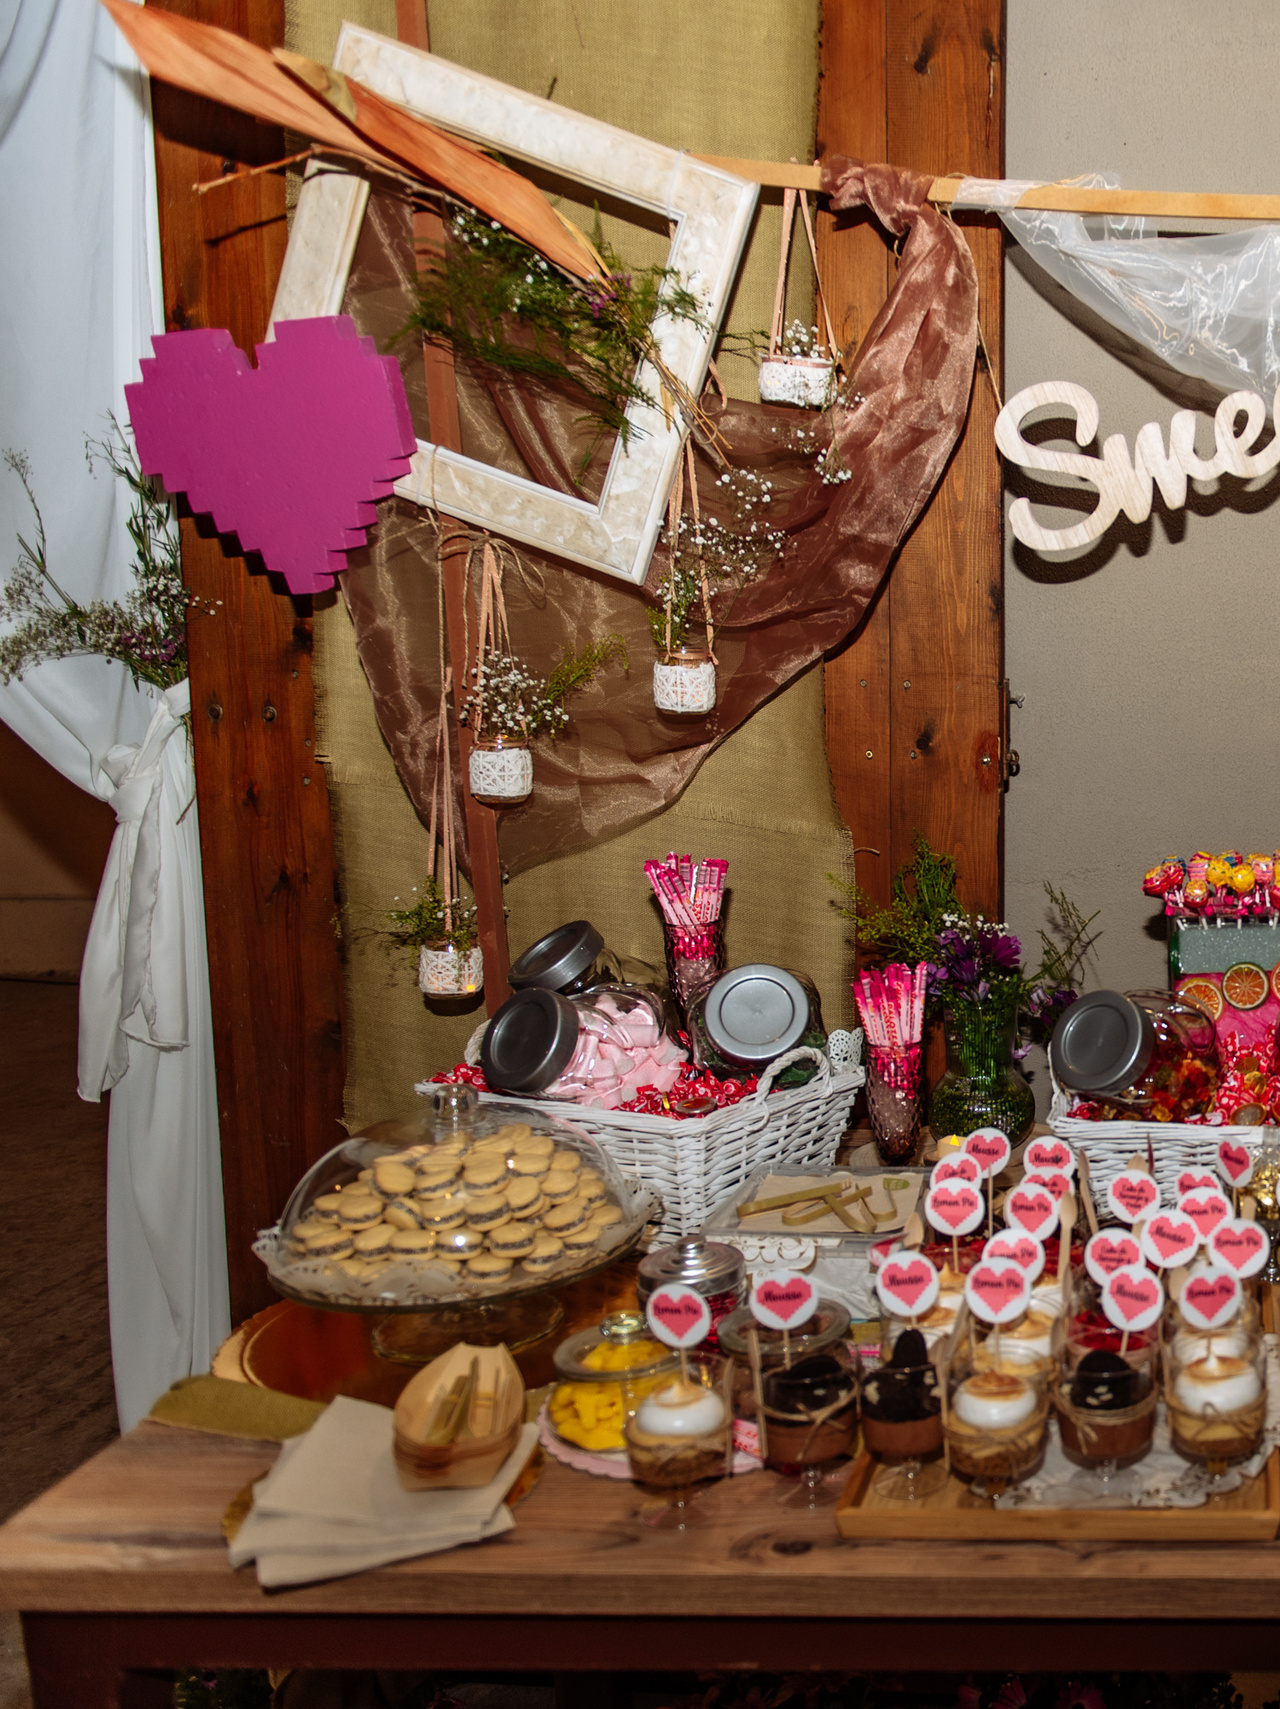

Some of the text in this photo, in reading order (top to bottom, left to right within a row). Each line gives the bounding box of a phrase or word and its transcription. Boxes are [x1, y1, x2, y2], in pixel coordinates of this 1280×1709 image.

[887, 1001, 898, 1045] PALOTES
[969, 1144, 999, 1155] Mousse
[887, 1274, 924, 1288] Mousse
[762, 1290, 802, 1302] Mousse
